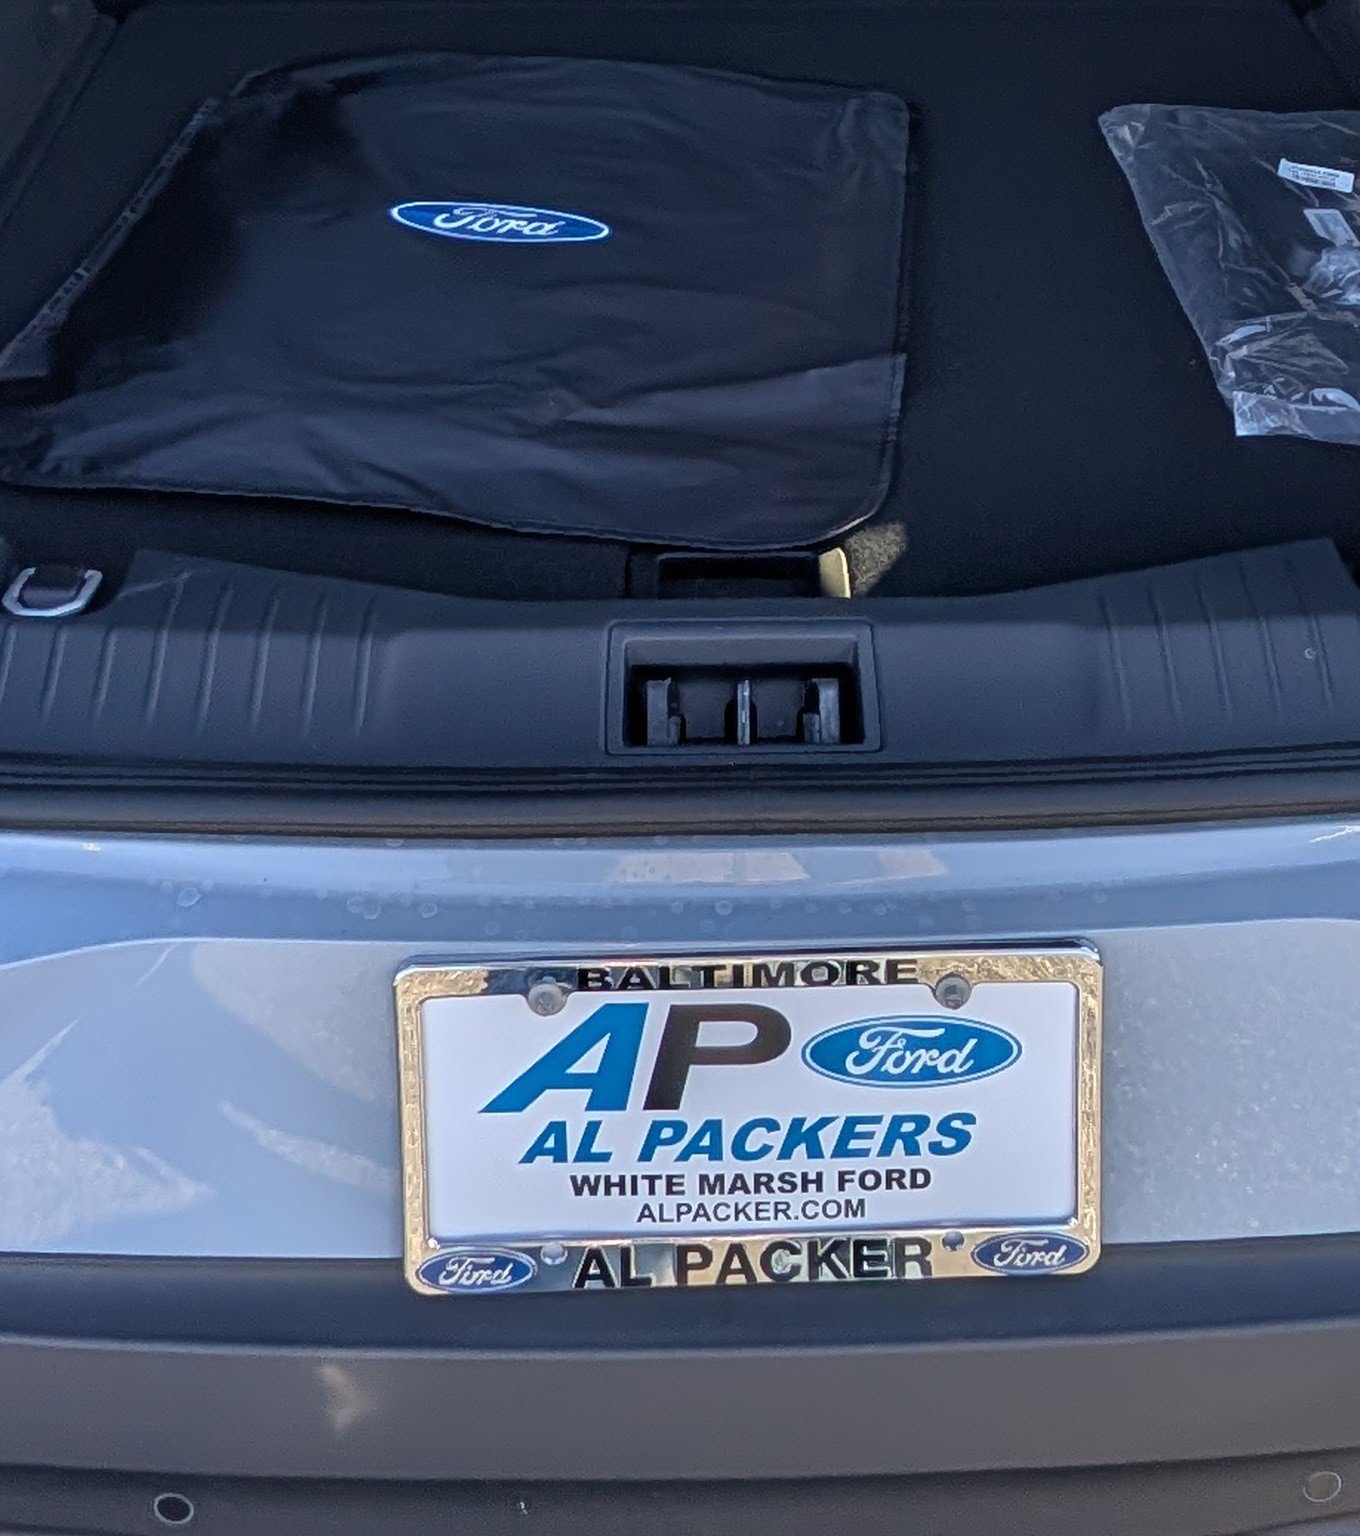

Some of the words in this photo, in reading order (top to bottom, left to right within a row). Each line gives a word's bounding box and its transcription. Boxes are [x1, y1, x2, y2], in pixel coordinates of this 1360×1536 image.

[433, 207, 566, 236] Ford
[576, 958, 919, 992] BALTIMORE
[478, 1002, 792, 1113] AP
[845, 1025, 979, 1076] Ford
[518, 1119, 614, 1164] AL
[637, 1112, 978, 1163] PACKERS
[569, 1173, 687, 1197] WHITE
[698, 1170, 824, 1195] MARSH
[837, 1167, 932, 1193] FORD
[636, 1198, 867, 1224] ALPACKER.COM
[571, 1247, 654, 1290] AL
[675, 1236, 934, 1286] PACKER
[993, 1238, 1068, 1269] Ford
[439, 1256, 514, 1286] Ford
